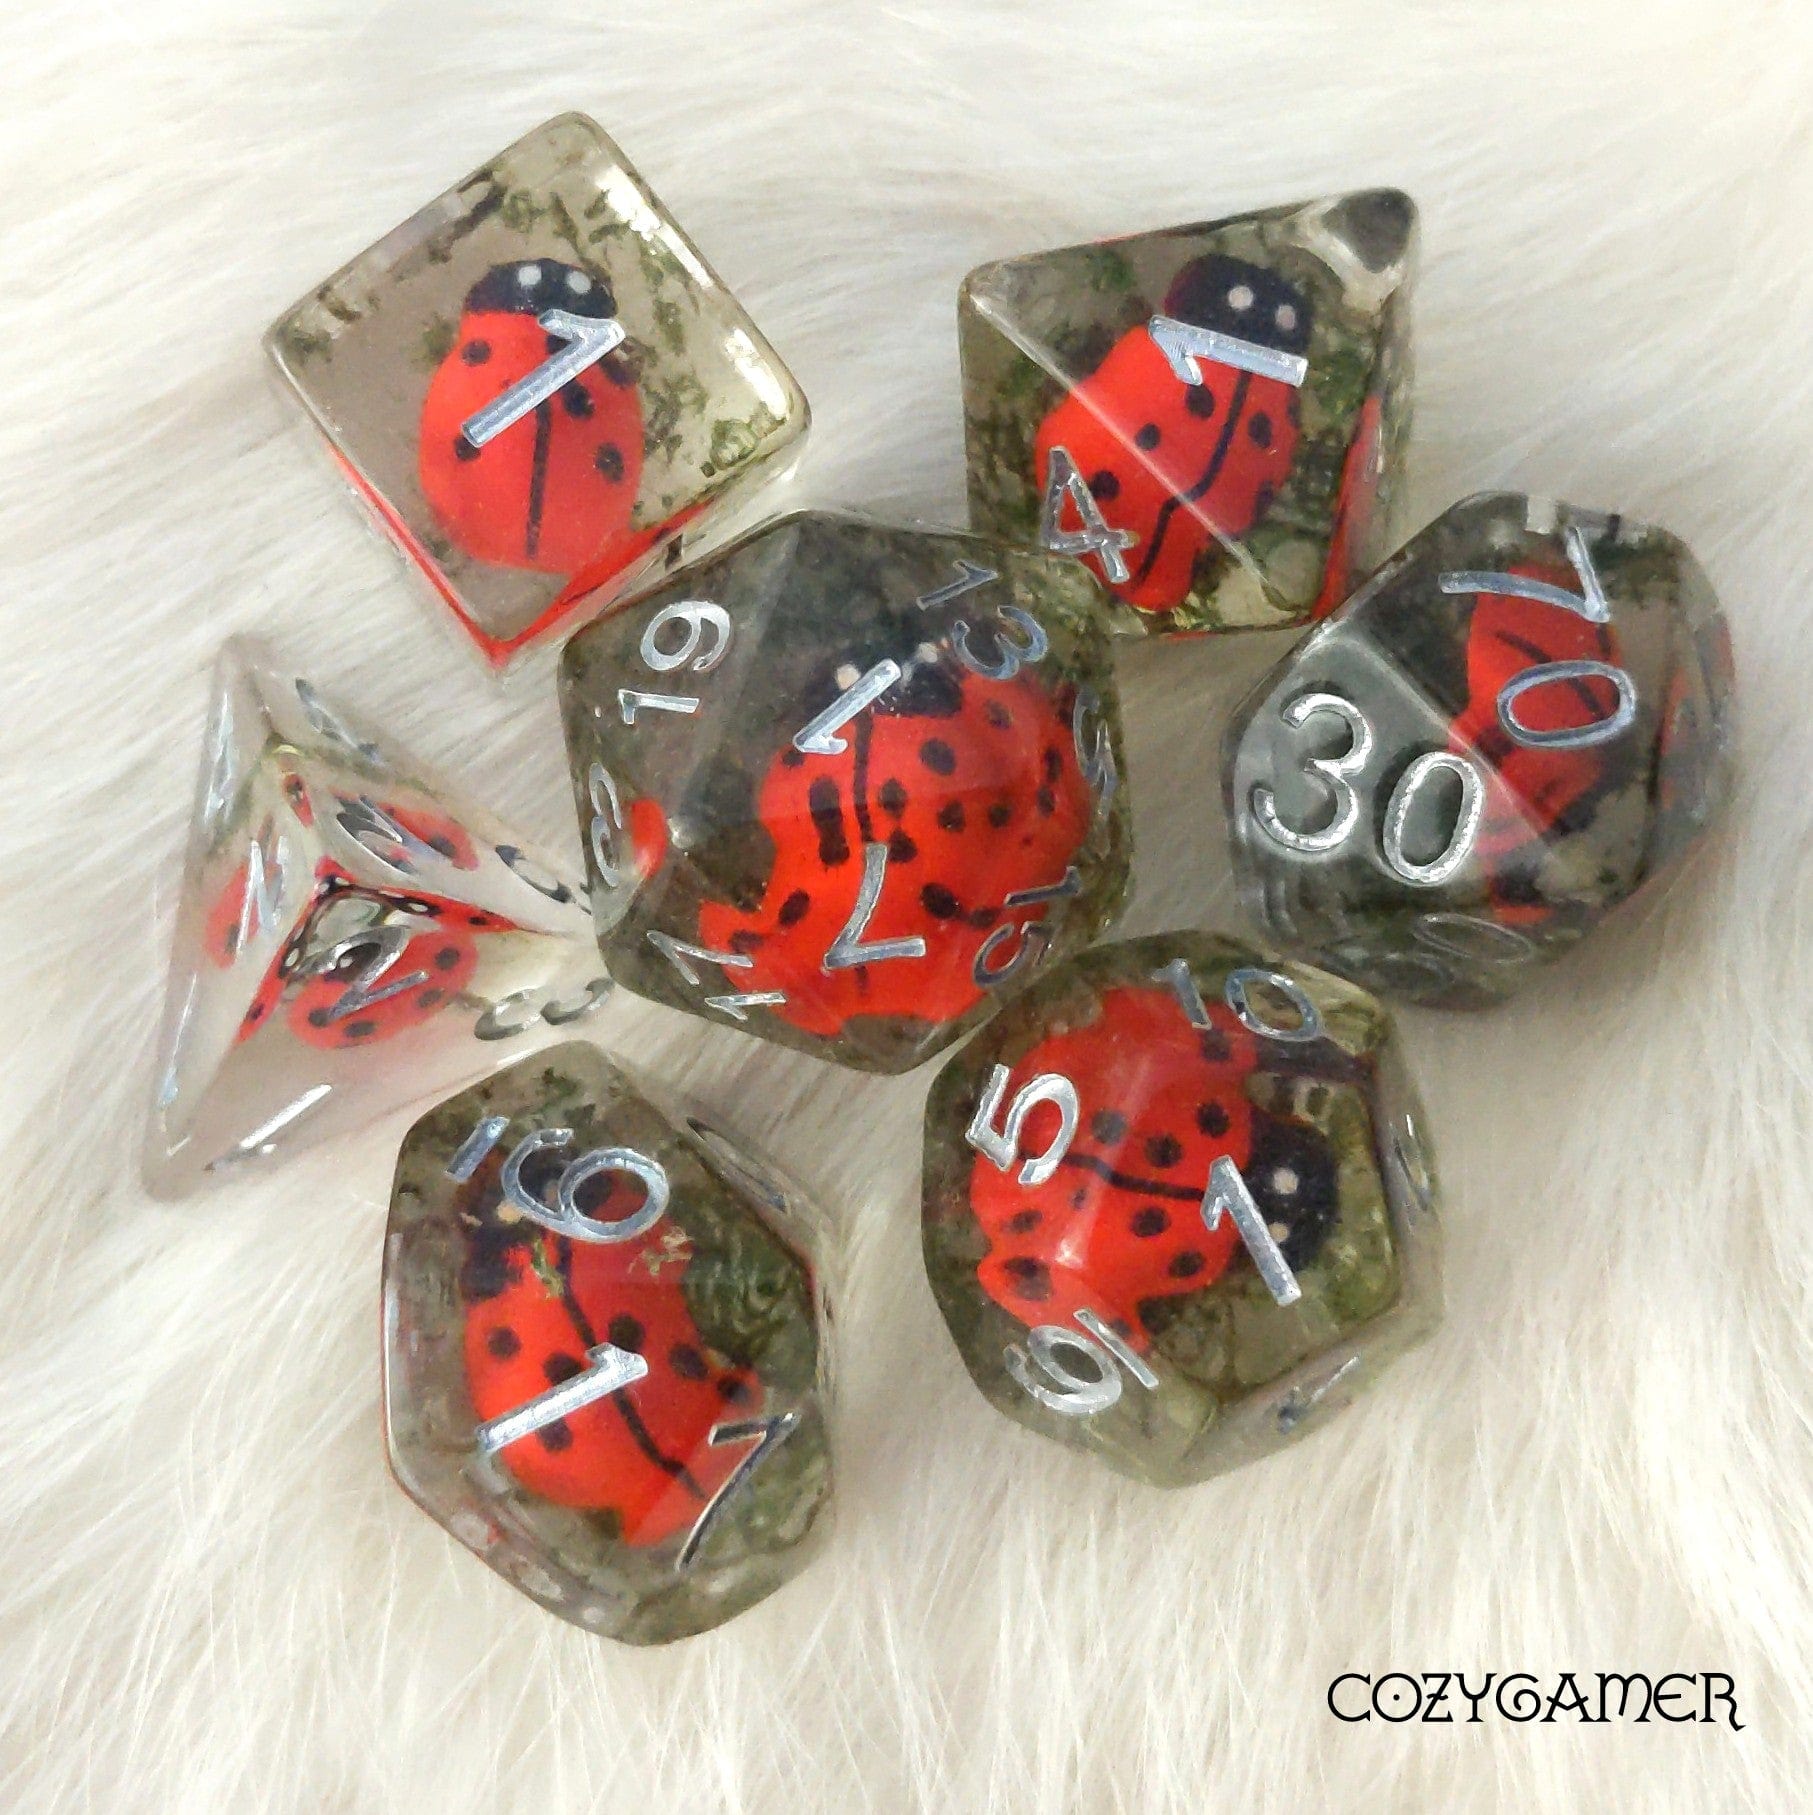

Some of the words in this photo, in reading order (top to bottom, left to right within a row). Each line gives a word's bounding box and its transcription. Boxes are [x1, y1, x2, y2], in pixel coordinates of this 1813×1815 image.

[461, 309, 625, 447] 1
[1149, 314, 1308, 387] 1
[1043, 446, 1140, 583] 4
[617, 600, 731, 725] 19
[917, 560, 1048, 680] 13
[1438, 526, 1638, 748] 70
[793, 658, 902, 755] 1
[1253, 692, 1486, 887] 30
[824, 842, 926, 972] 7
[1152, 958, 1324, 1042] 10
[966, 1064, 1080, 1185] 5
[1200, 1155, 1302, 1305] 1
[474, 1342, 649, 1456] 1
[674, 1412, 799, 1573] 7
